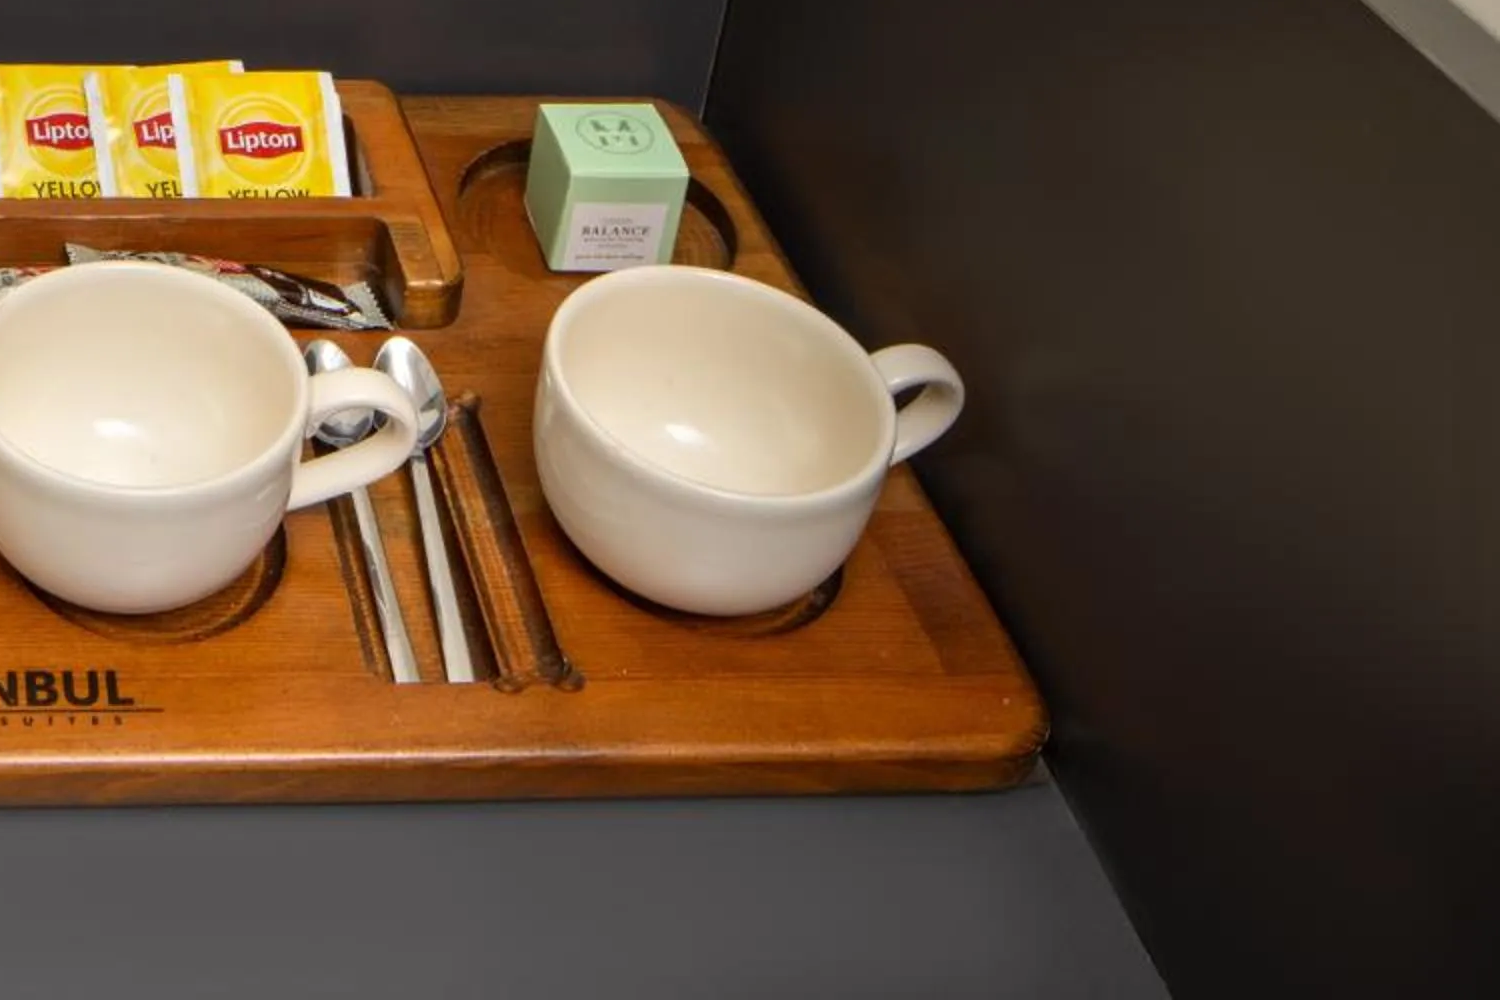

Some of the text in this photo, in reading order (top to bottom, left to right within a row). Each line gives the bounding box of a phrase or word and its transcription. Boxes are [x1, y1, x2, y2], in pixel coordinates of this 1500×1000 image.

[226, 130, 297, 152] Lipton
[33, 180, 100, 198] YELLO
[581, 226, 651, 236] BALANCE
